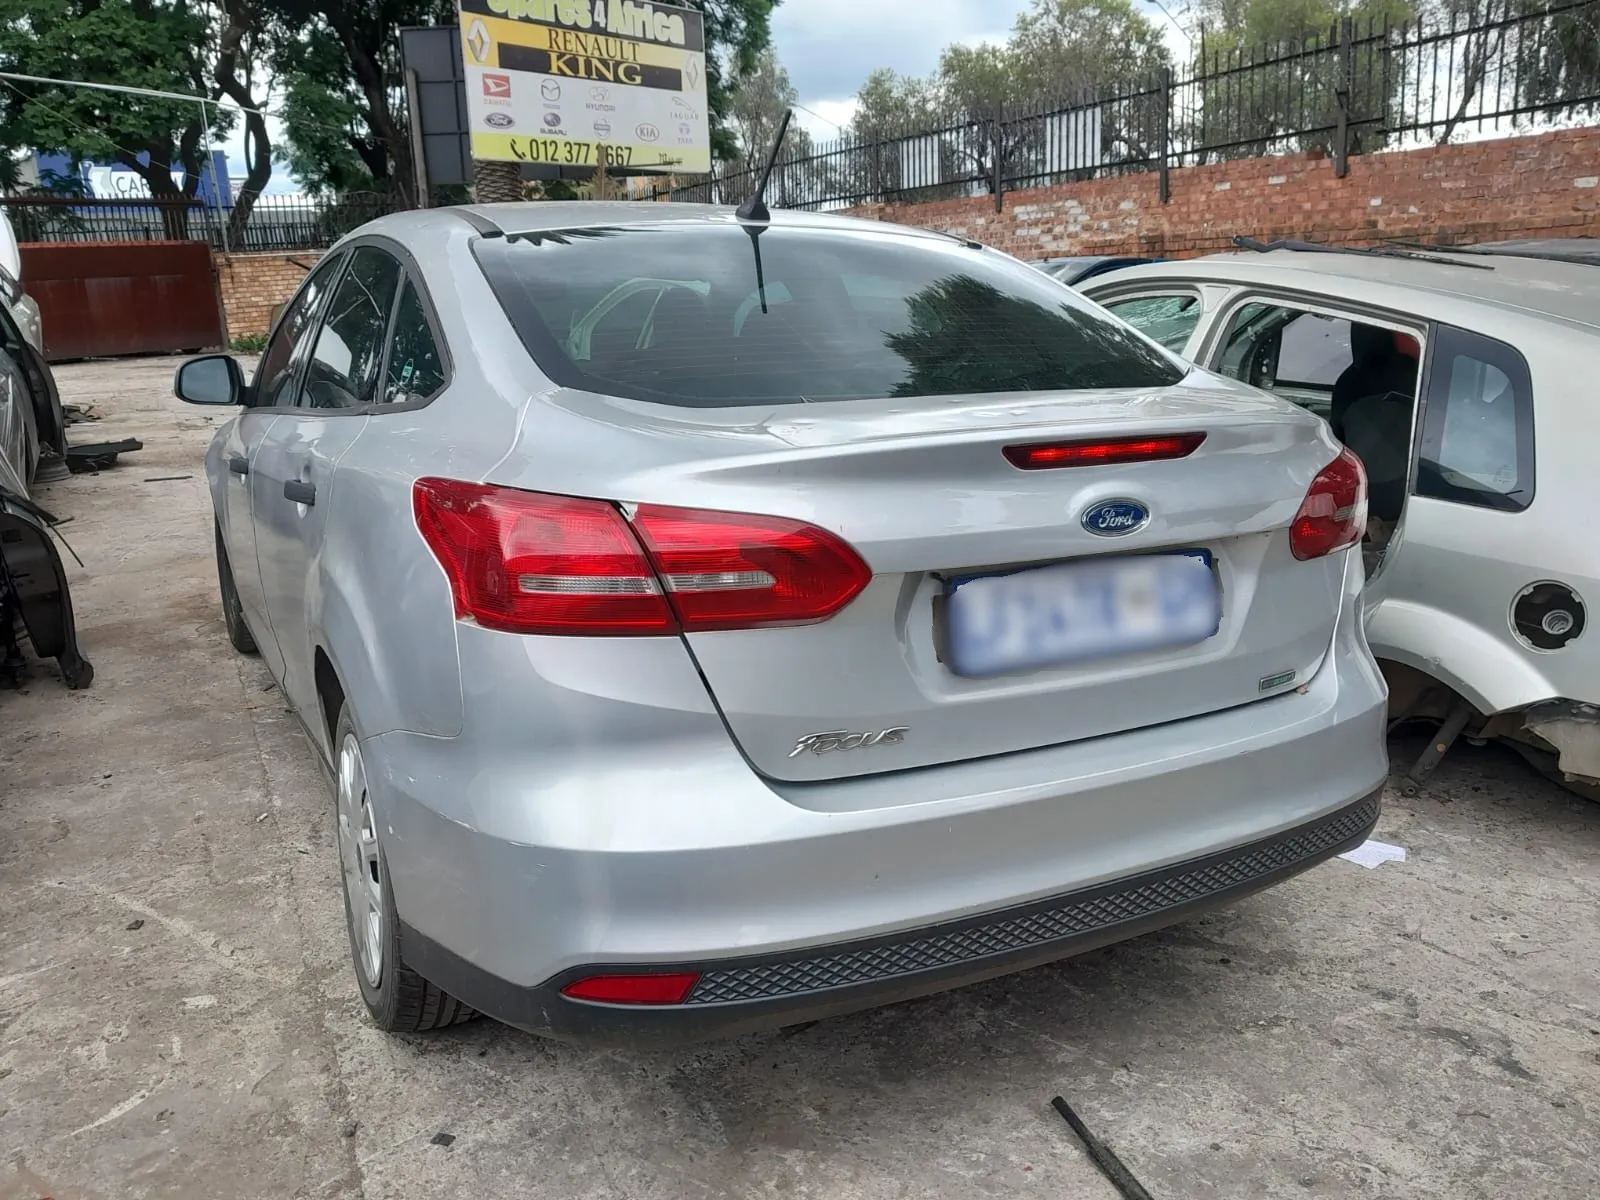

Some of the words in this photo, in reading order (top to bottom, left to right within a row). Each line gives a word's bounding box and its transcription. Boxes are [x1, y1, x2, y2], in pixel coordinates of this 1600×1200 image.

[548, 28, 639, 62] RENAULT
[548, 51, 643, 85] KING
[640, 127, 656, 137] KIA
[529, 139, 559, 161] 012
[564, 142, 590, 164] 377
[1099, 507, 1135, 528] Ford
